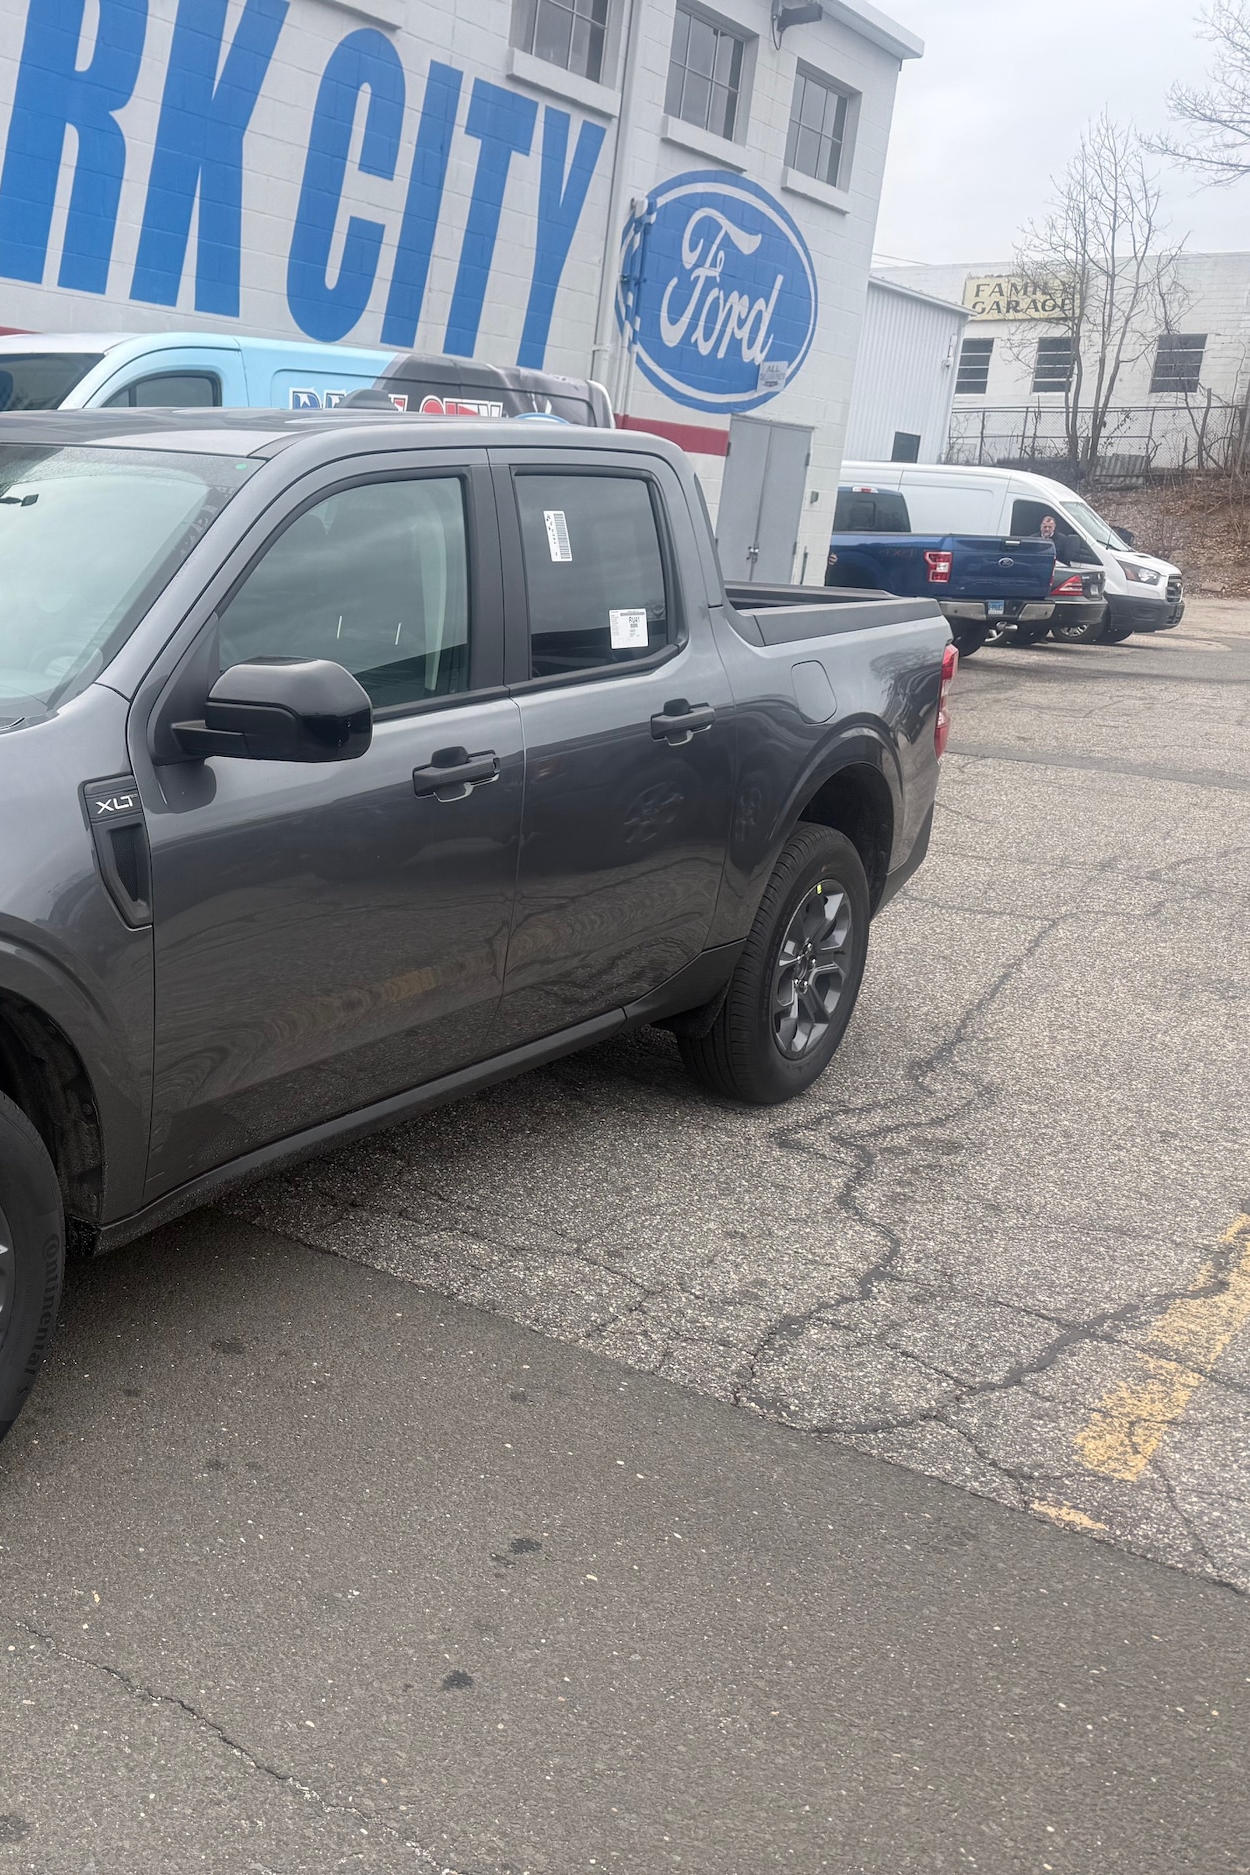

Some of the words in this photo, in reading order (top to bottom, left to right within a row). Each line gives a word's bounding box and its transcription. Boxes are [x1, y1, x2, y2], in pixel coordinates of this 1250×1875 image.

[286, 28, 607, 370] CITY
[659, 206, 784, 366] Ford
[971, 298, 1072, 314] GARAGE
[95, 794, 138, 815] XLT
